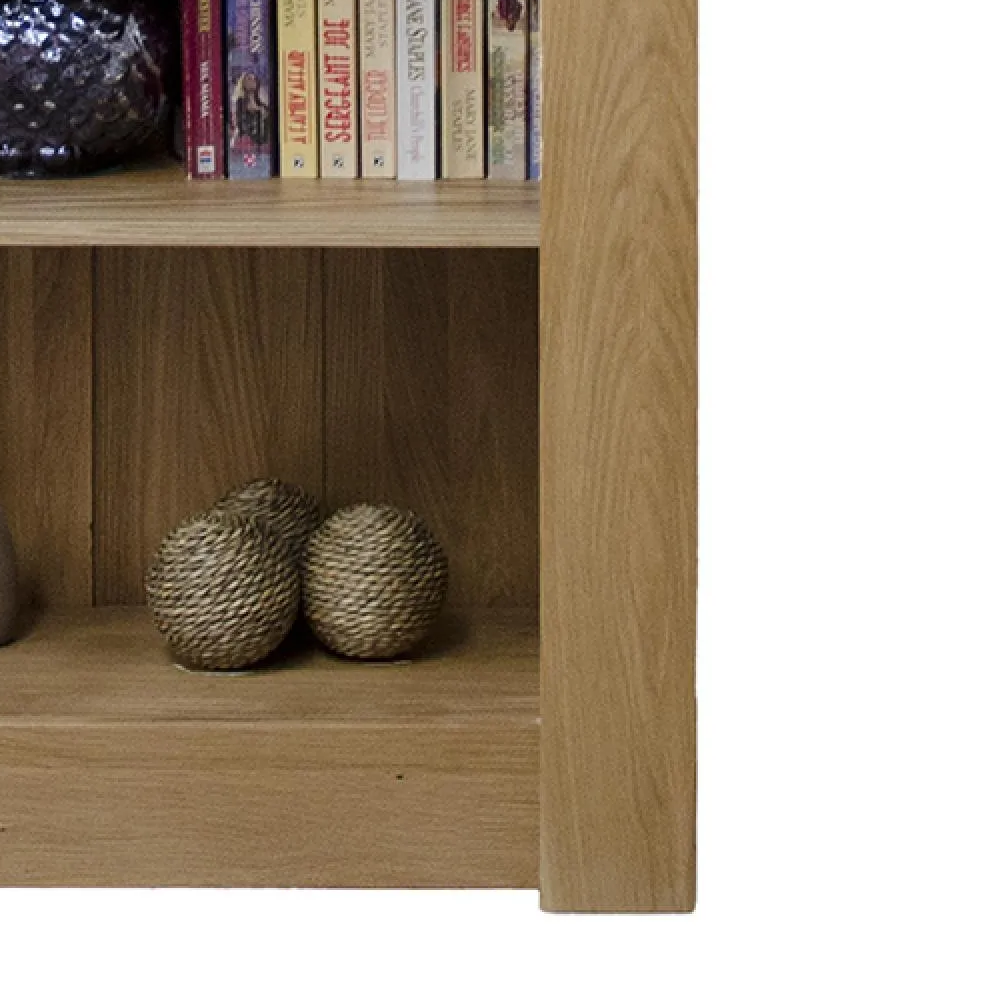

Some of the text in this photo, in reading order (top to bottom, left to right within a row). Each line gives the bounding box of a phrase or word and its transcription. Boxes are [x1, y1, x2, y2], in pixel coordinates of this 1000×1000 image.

[364, 18, 376, 58] MARY
[406, 26, 429, 81] STAPLES
[323, 18, 352, 144] SERGEANT JOE
[465, 88, 477, 161] MARY JANE
